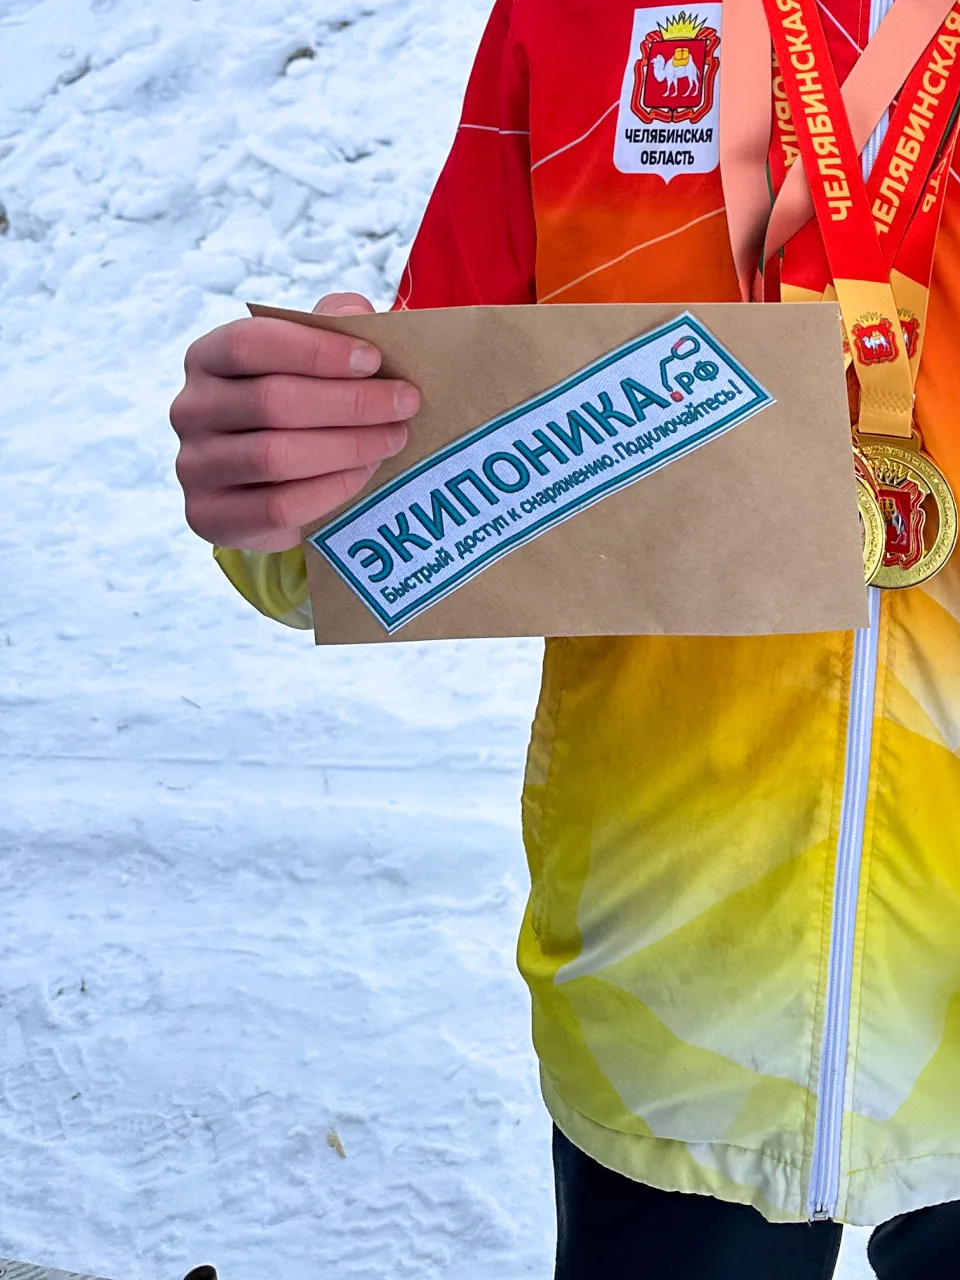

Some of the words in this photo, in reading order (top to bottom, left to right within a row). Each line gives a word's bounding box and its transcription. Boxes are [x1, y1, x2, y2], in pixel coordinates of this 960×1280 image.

[625, 128, 713, 143] ЧЕЛЯБИНСКАЯ
[640, 150, 695, 165] ОБЛАСТЬ
[379, 546, 455, 605] Быстрый
[454, 514, 510, 560] доступ
[506, 507, 522, 522] к
